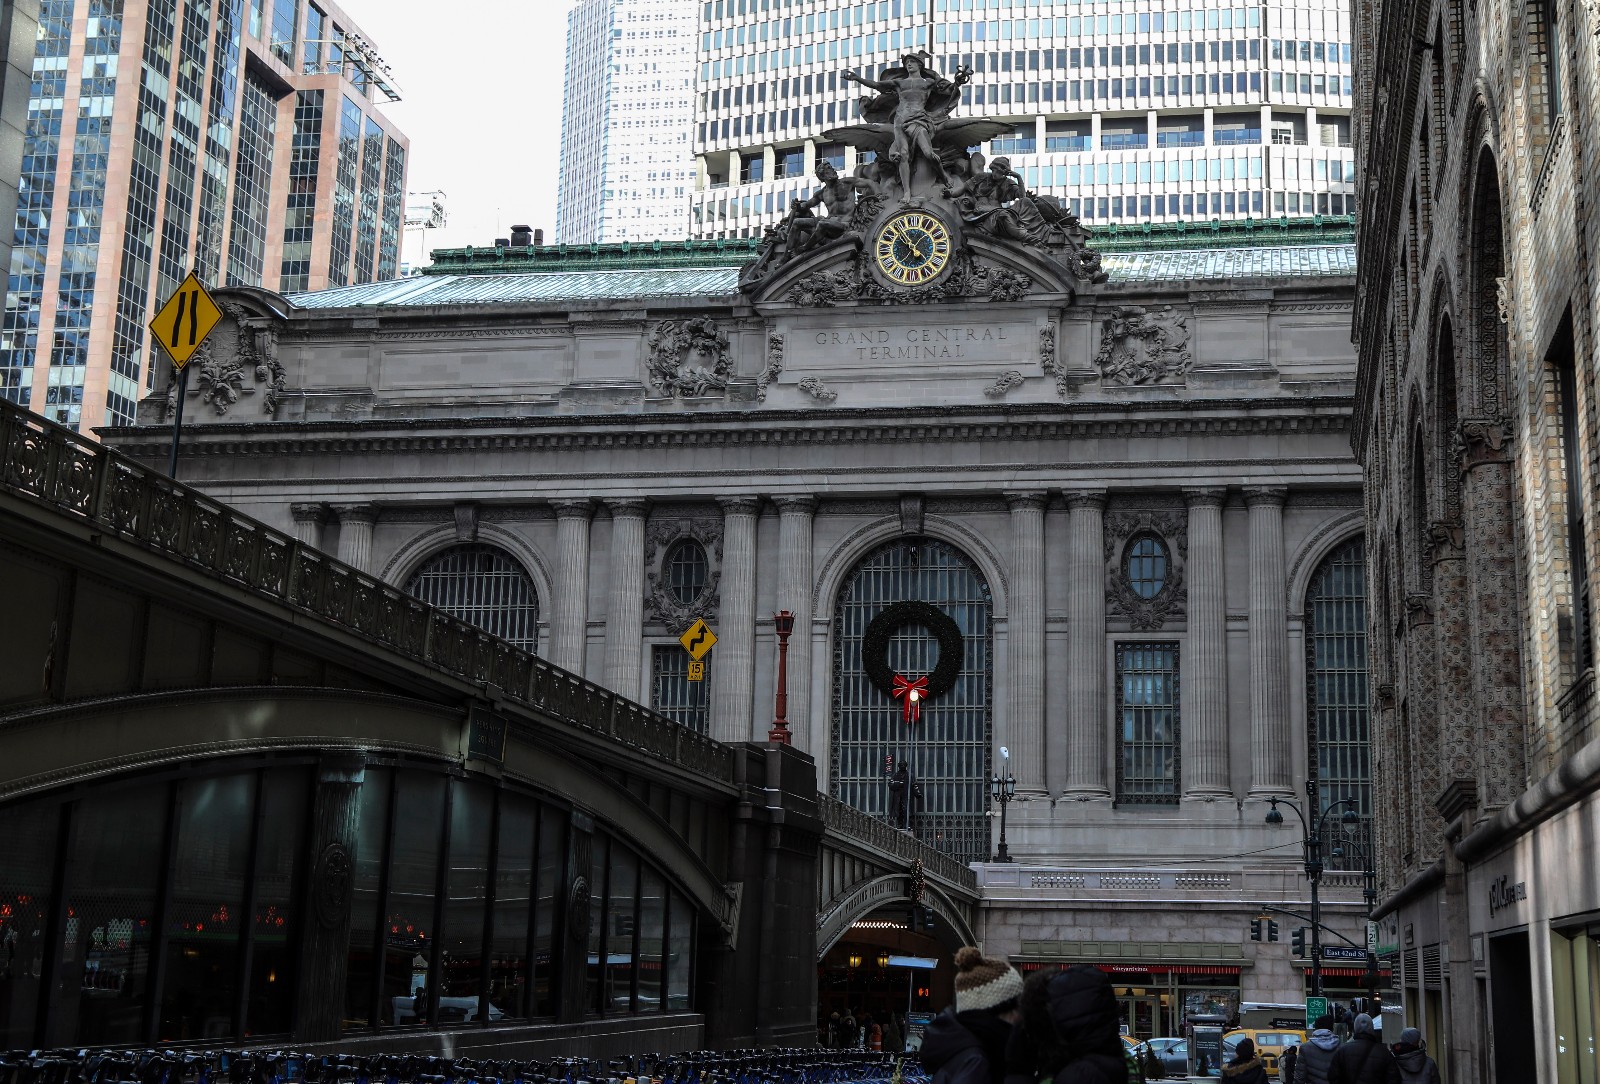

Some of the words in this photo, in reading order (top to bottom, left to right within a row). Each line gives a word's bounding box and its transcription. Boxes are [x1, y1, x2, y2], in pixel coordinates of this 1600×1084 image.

[816, 330, 890, 345] GRAND
[906, 328, 1008, 342] CENTRAL
[856, 345, 965, 360] TERMINAL
[692, 664, 700, 673] 15
